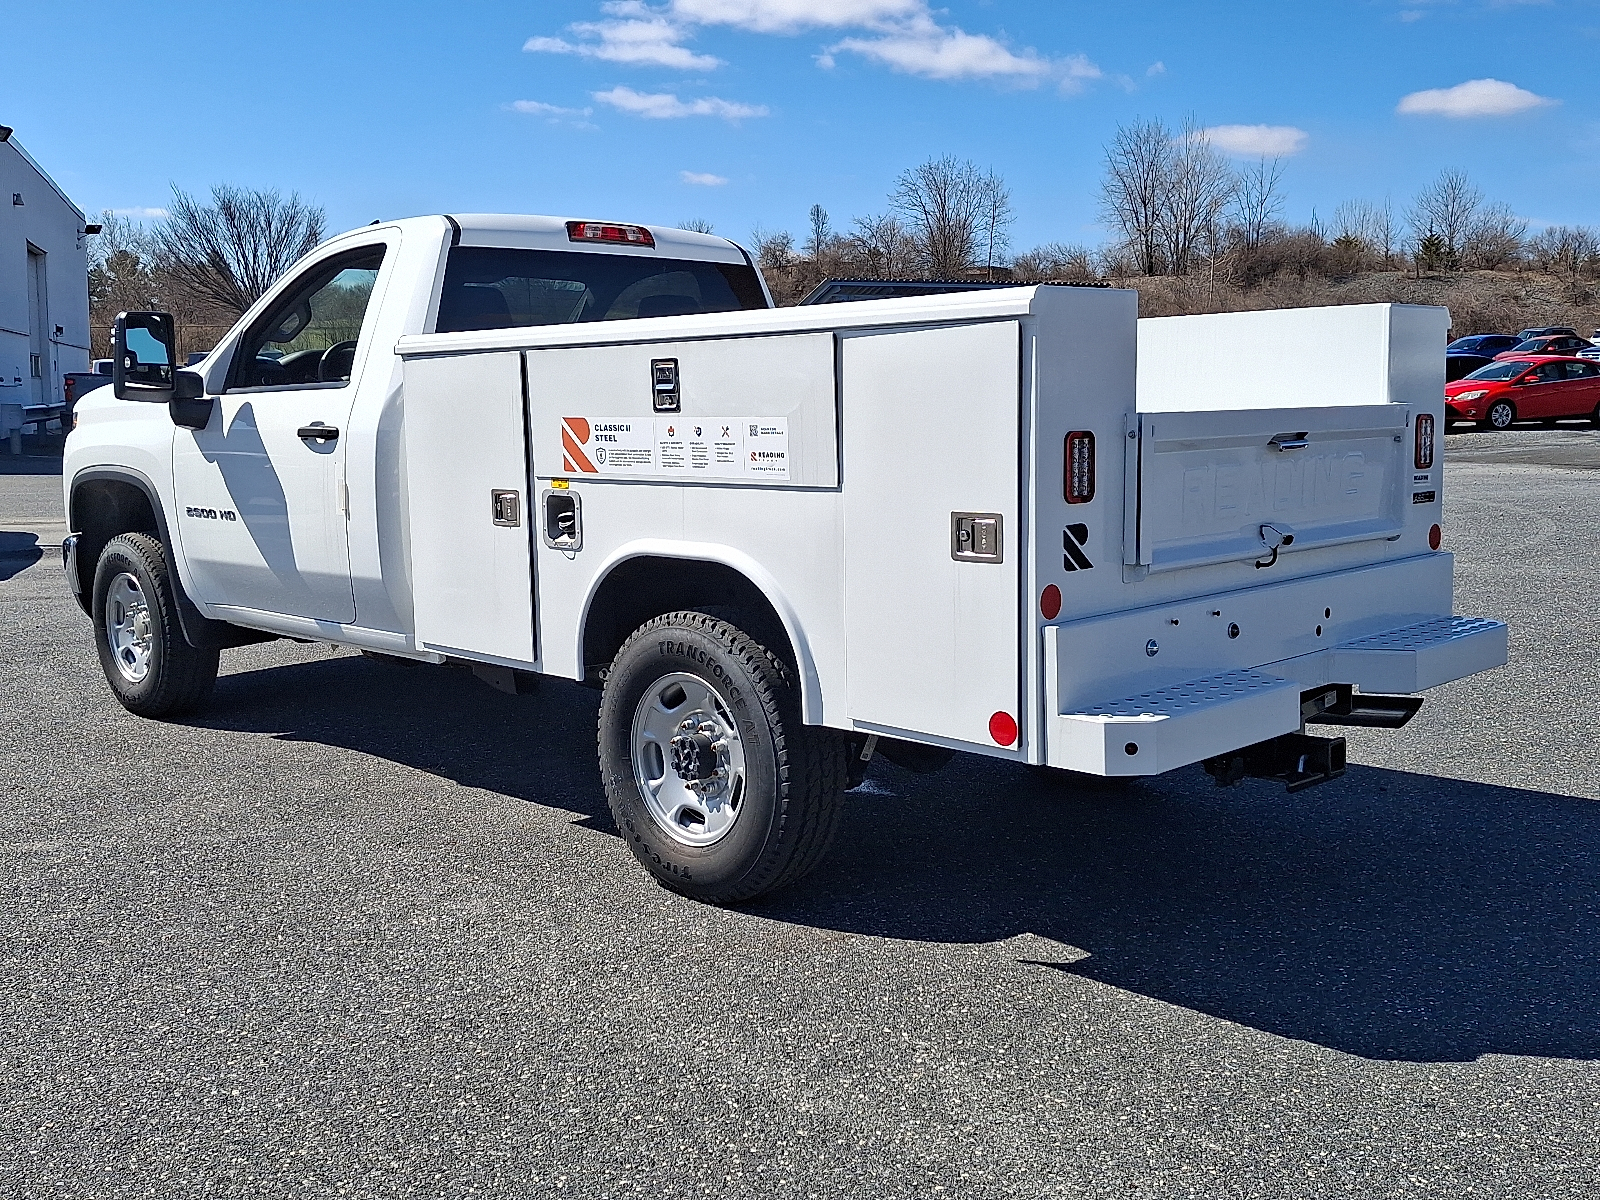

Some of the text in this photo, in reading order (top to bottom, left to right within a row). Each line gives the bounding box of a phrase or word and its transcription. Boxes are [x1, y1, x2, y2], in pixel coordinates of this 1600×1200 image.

[594, 424, 625, 432] CLASSIC
[594, 434, 618, 442] STEEL
[657, 640, 748, 712] TRANSFORCE
